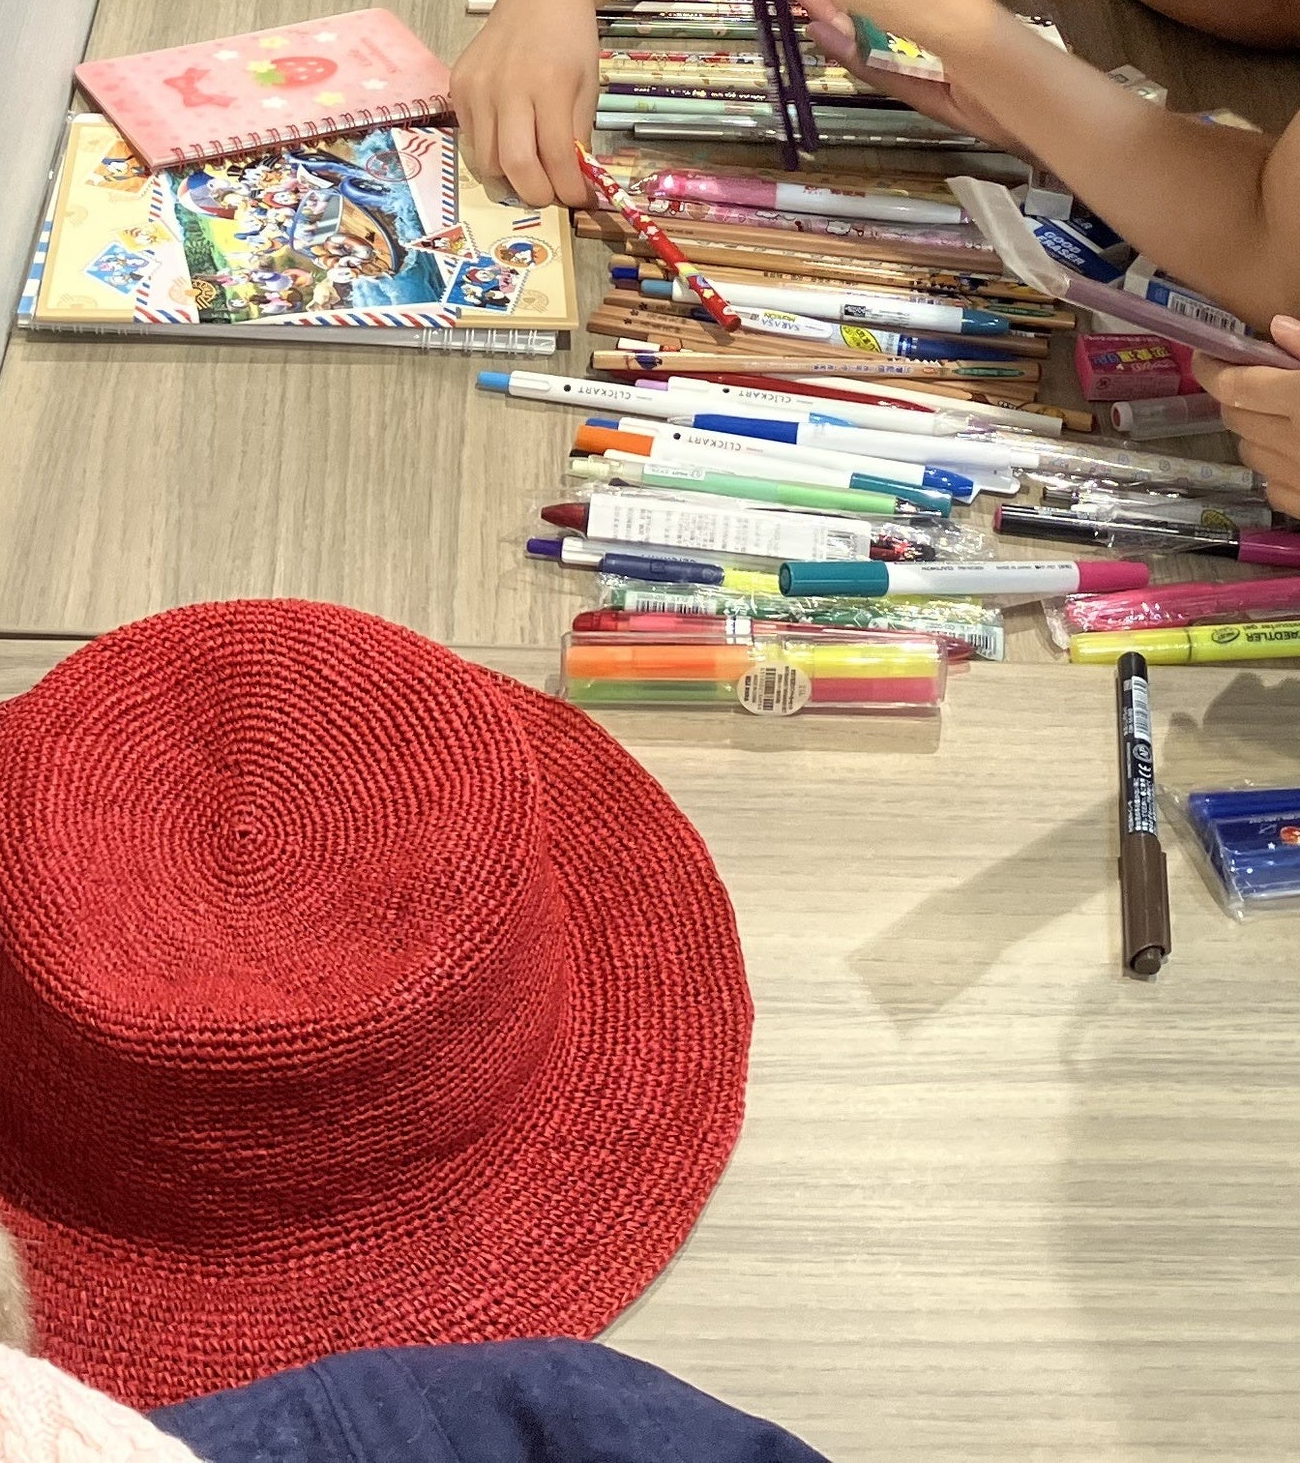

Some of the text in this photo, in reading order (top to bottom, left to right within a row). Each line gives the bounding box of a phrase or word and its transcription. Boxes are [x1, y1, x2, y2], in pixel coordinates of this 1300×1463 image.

[1037, 235, 1086, 265] ERASER
[1044, 232, 1081, 253] GOOD
[762, 318, 801, 331] SARASA
[577, 386, 632, 400] CLICKART
[738, 390, 792, 404] CLICKART
[688, 435, 741, 451] CLICKART
